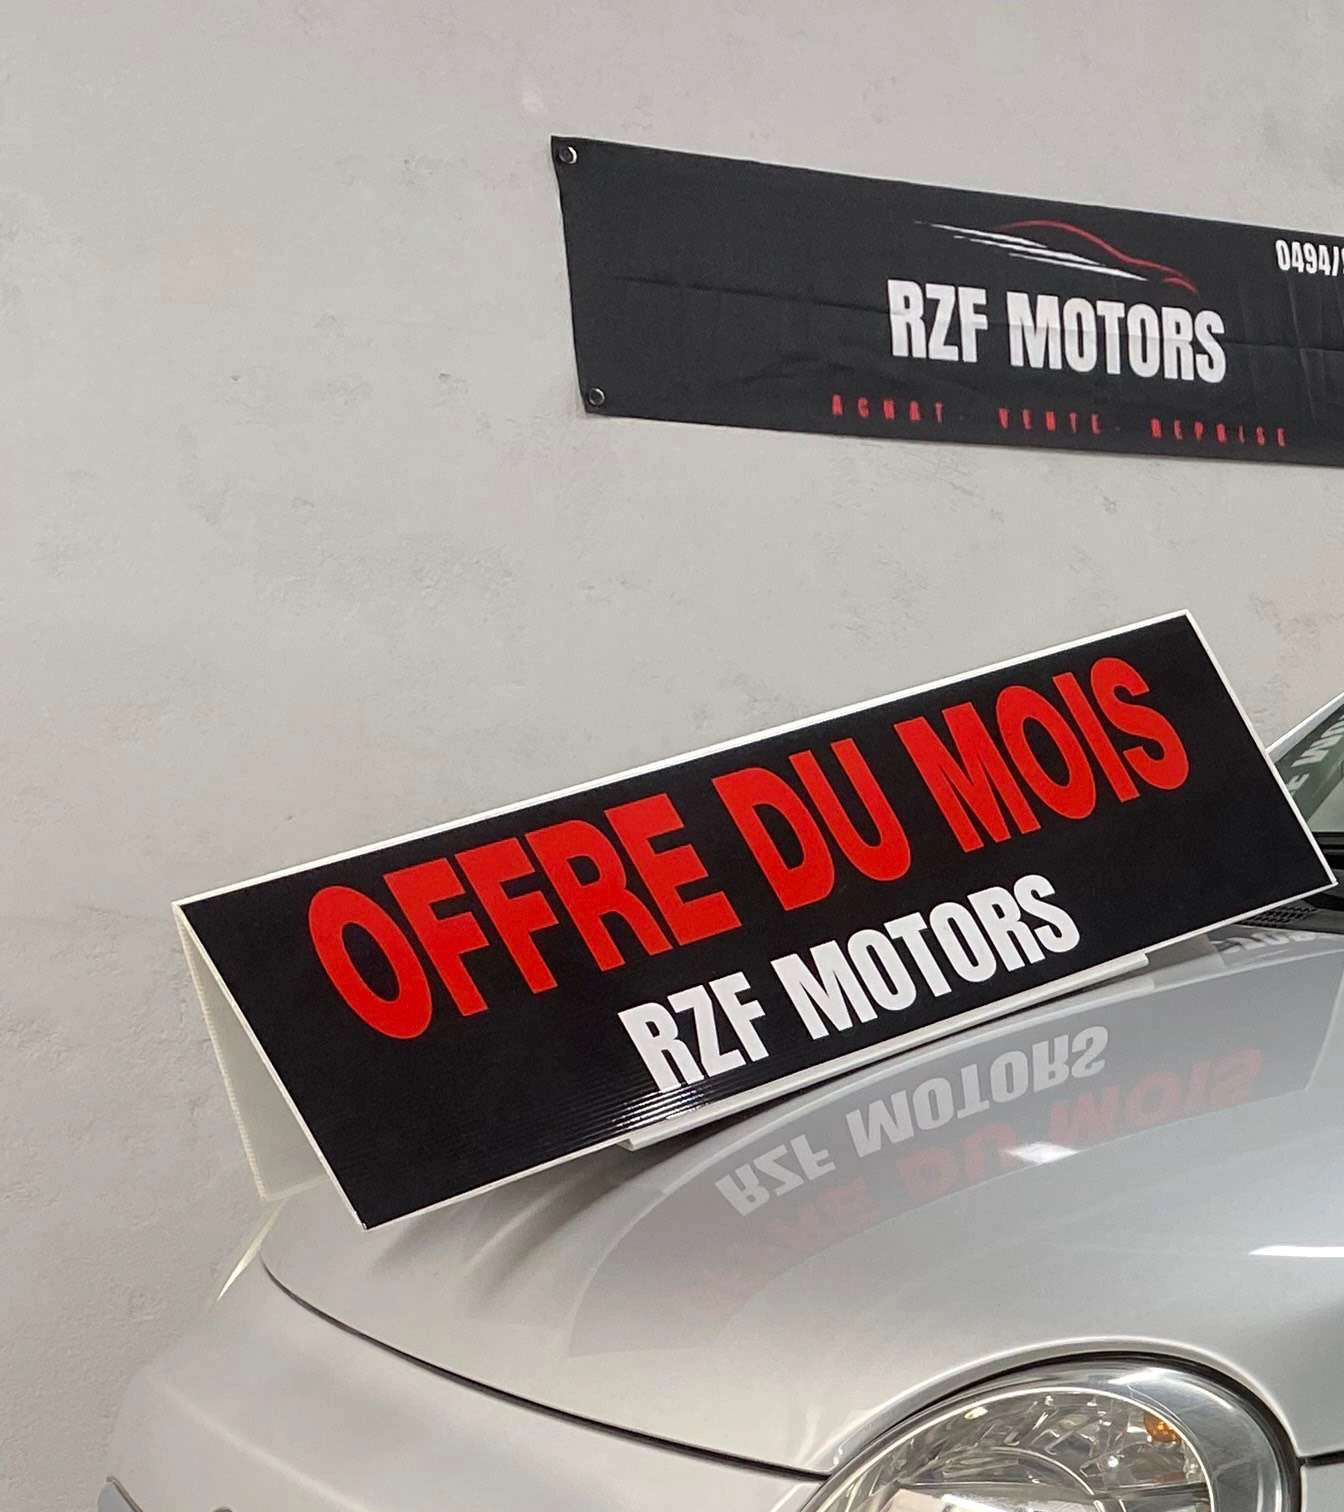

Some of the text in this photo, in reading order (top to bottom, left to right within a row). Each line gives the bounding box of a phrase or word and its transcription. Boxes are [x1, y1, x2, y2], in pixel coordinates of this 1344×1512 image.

[887, 279, 1226, 383] RZF MOTORS
[832, 394, 1285, 447] ACHAT VENTE REPRISE
[307, 656, 1189, 1039] OFFRE DU MOIS
[617, 874, 1080, 1093] RZF MOTORS
